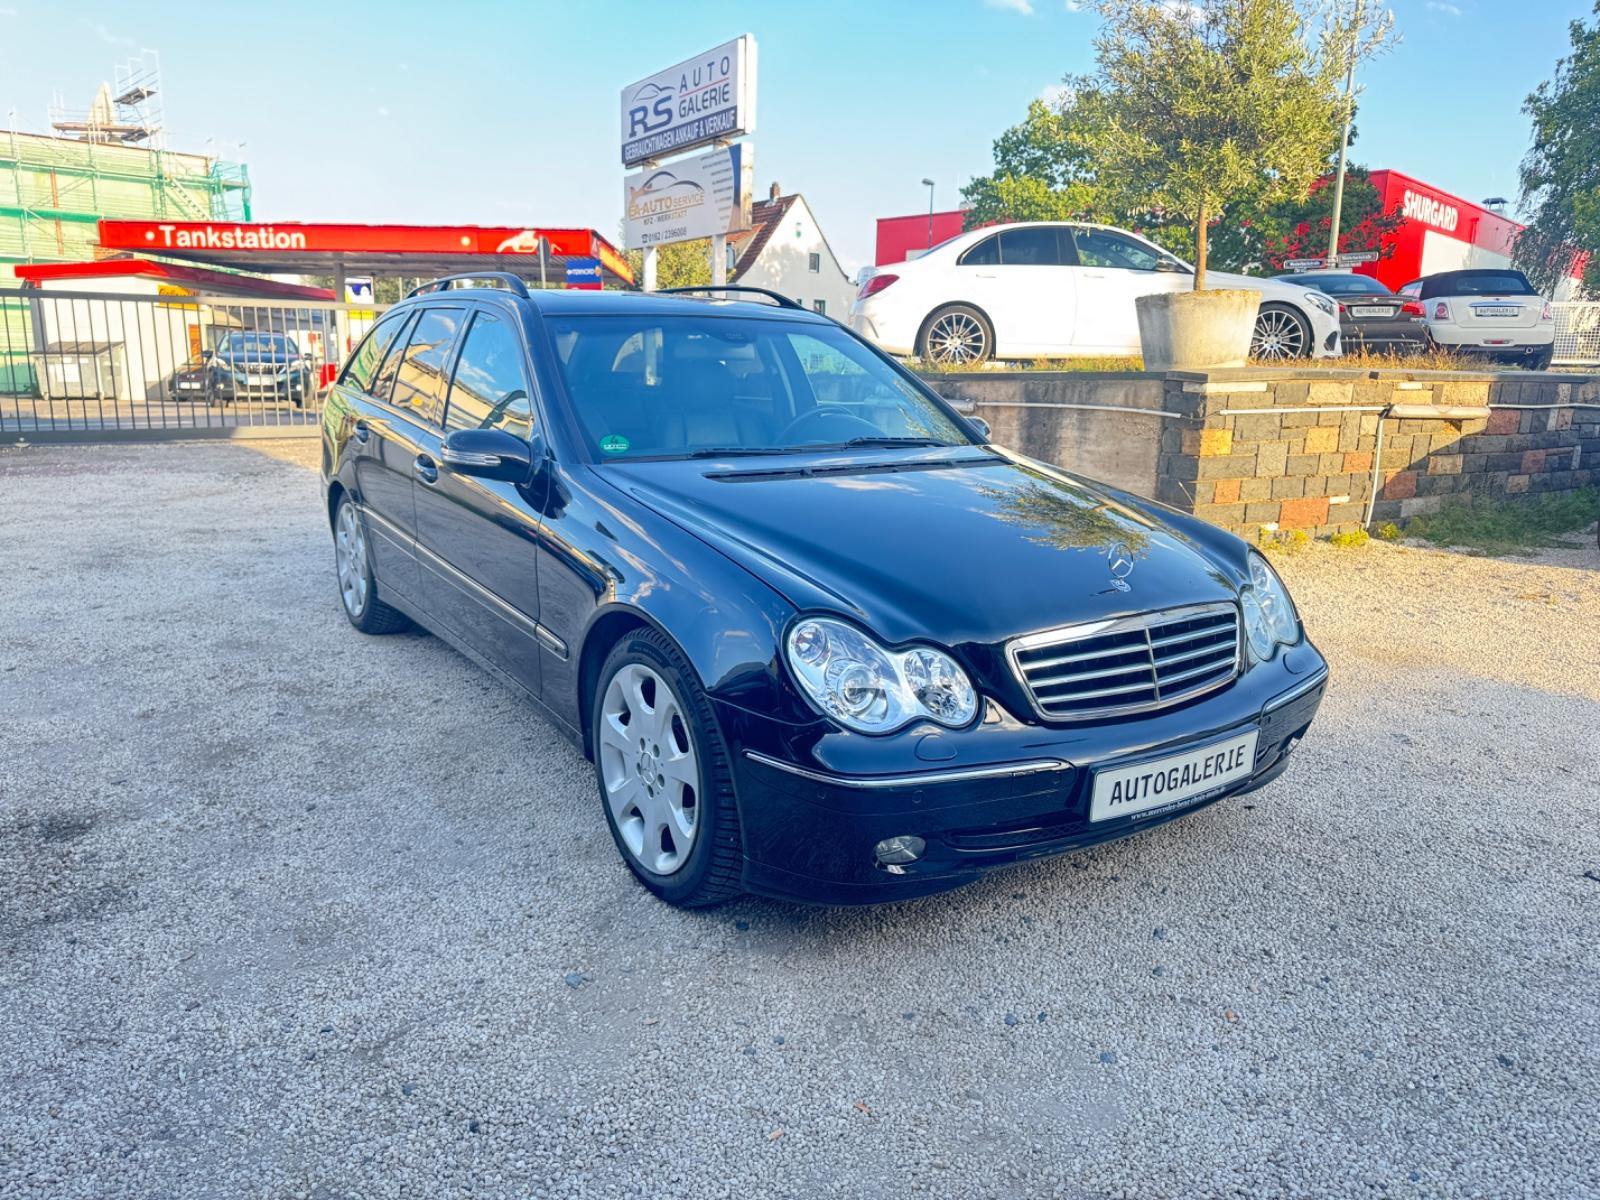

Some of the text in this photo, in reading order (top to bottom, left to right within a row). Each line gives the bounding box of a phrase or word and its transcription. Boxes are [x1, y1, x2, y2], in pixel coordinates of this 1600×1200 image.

[680, 56, 730, 93] AUTO
[629, 95, 673, 138] RS
[679, 83, 730, 118] GALERIE
[625, 131, 675, 160] GEBRAUCHTWAGEN
[675, 122, 699, 144] ANKAUF
[705, 110, 736, 135] VERKAUF
[1403, 190, 1458, 232] SHURGARD
[159, 225, 306, 249] Tankstation
[1109, 744, 1247, 806] AUTOGALERIE
